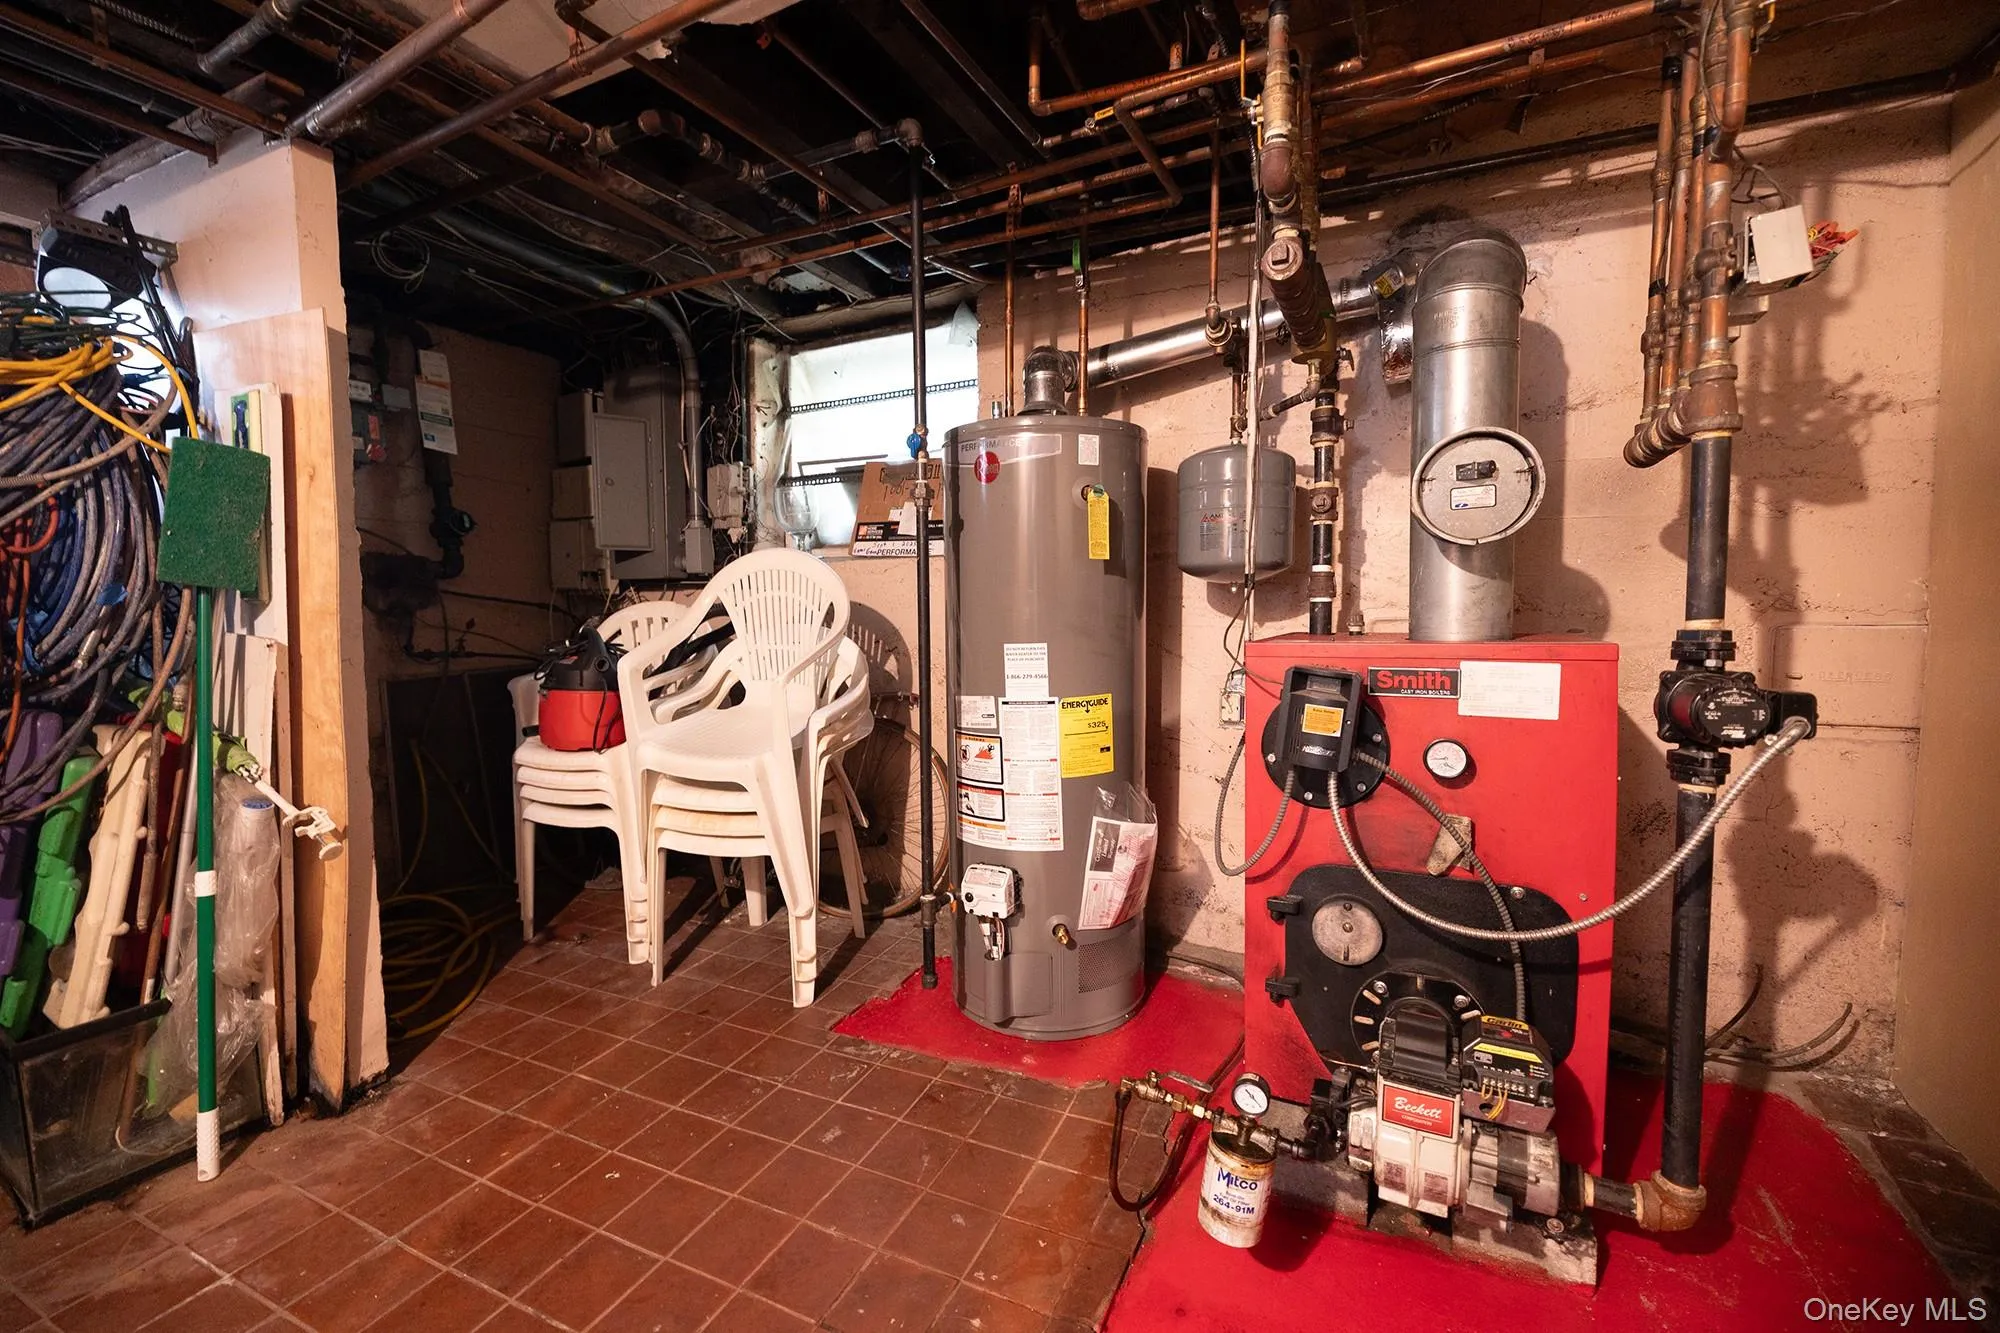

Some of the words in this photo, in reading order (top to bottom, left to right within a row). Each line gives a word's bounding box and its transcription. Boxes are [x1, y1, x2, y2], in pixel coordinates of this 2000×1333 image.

[961, 438, 1021, 451] PERFRMACE
[876, 547, 931, 556] PERFORMA
[1376, 670, 1451, 690] Smith
[1061, 697, 1109, 711] ENERGYGUIDE
[1487, 1018, 1523, 1029] Carlin
[1394, 1096, 1443, 1119] Beckett
[1217, 1167, 1258, 1191] Mitco
[1213, 1193, 1255, 1215] 264-91M
